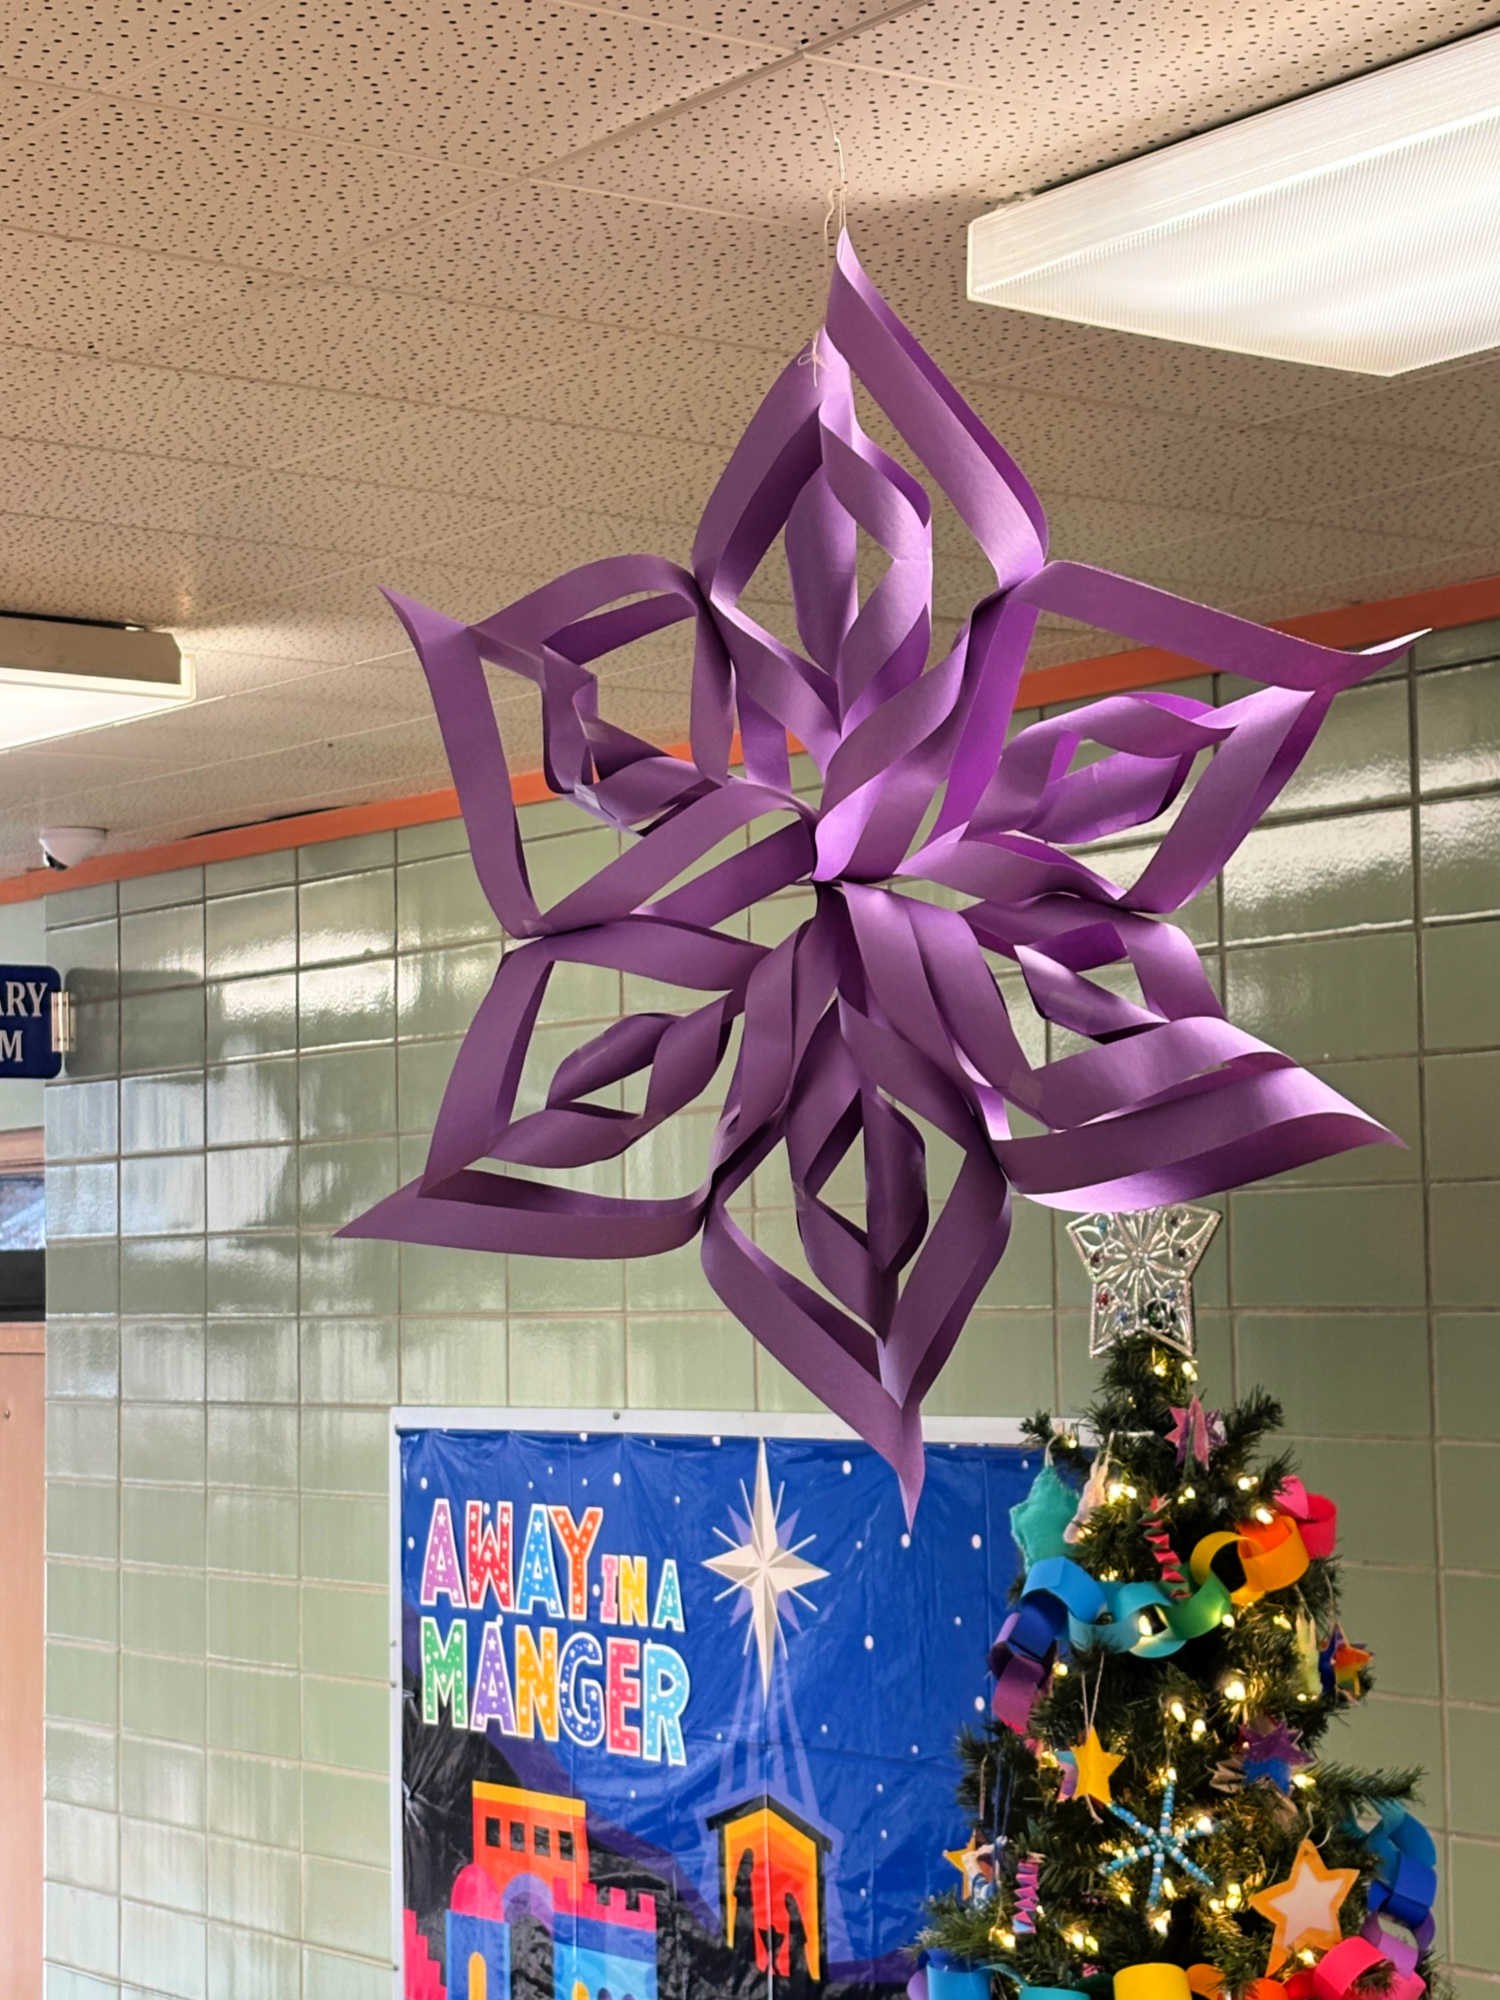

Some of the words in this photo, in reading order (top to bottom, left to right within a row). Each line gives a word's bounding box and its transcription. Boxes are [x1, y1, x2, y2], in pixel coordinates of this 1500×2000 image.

[0, 981, 48, 1017] RY
[420, 1499, 603, 1620] AWAY
[600, 1554, 648, 1627] IN
[652, 1559, 685, 1632] A
[420, 1616, 690, 1766] MANGER
